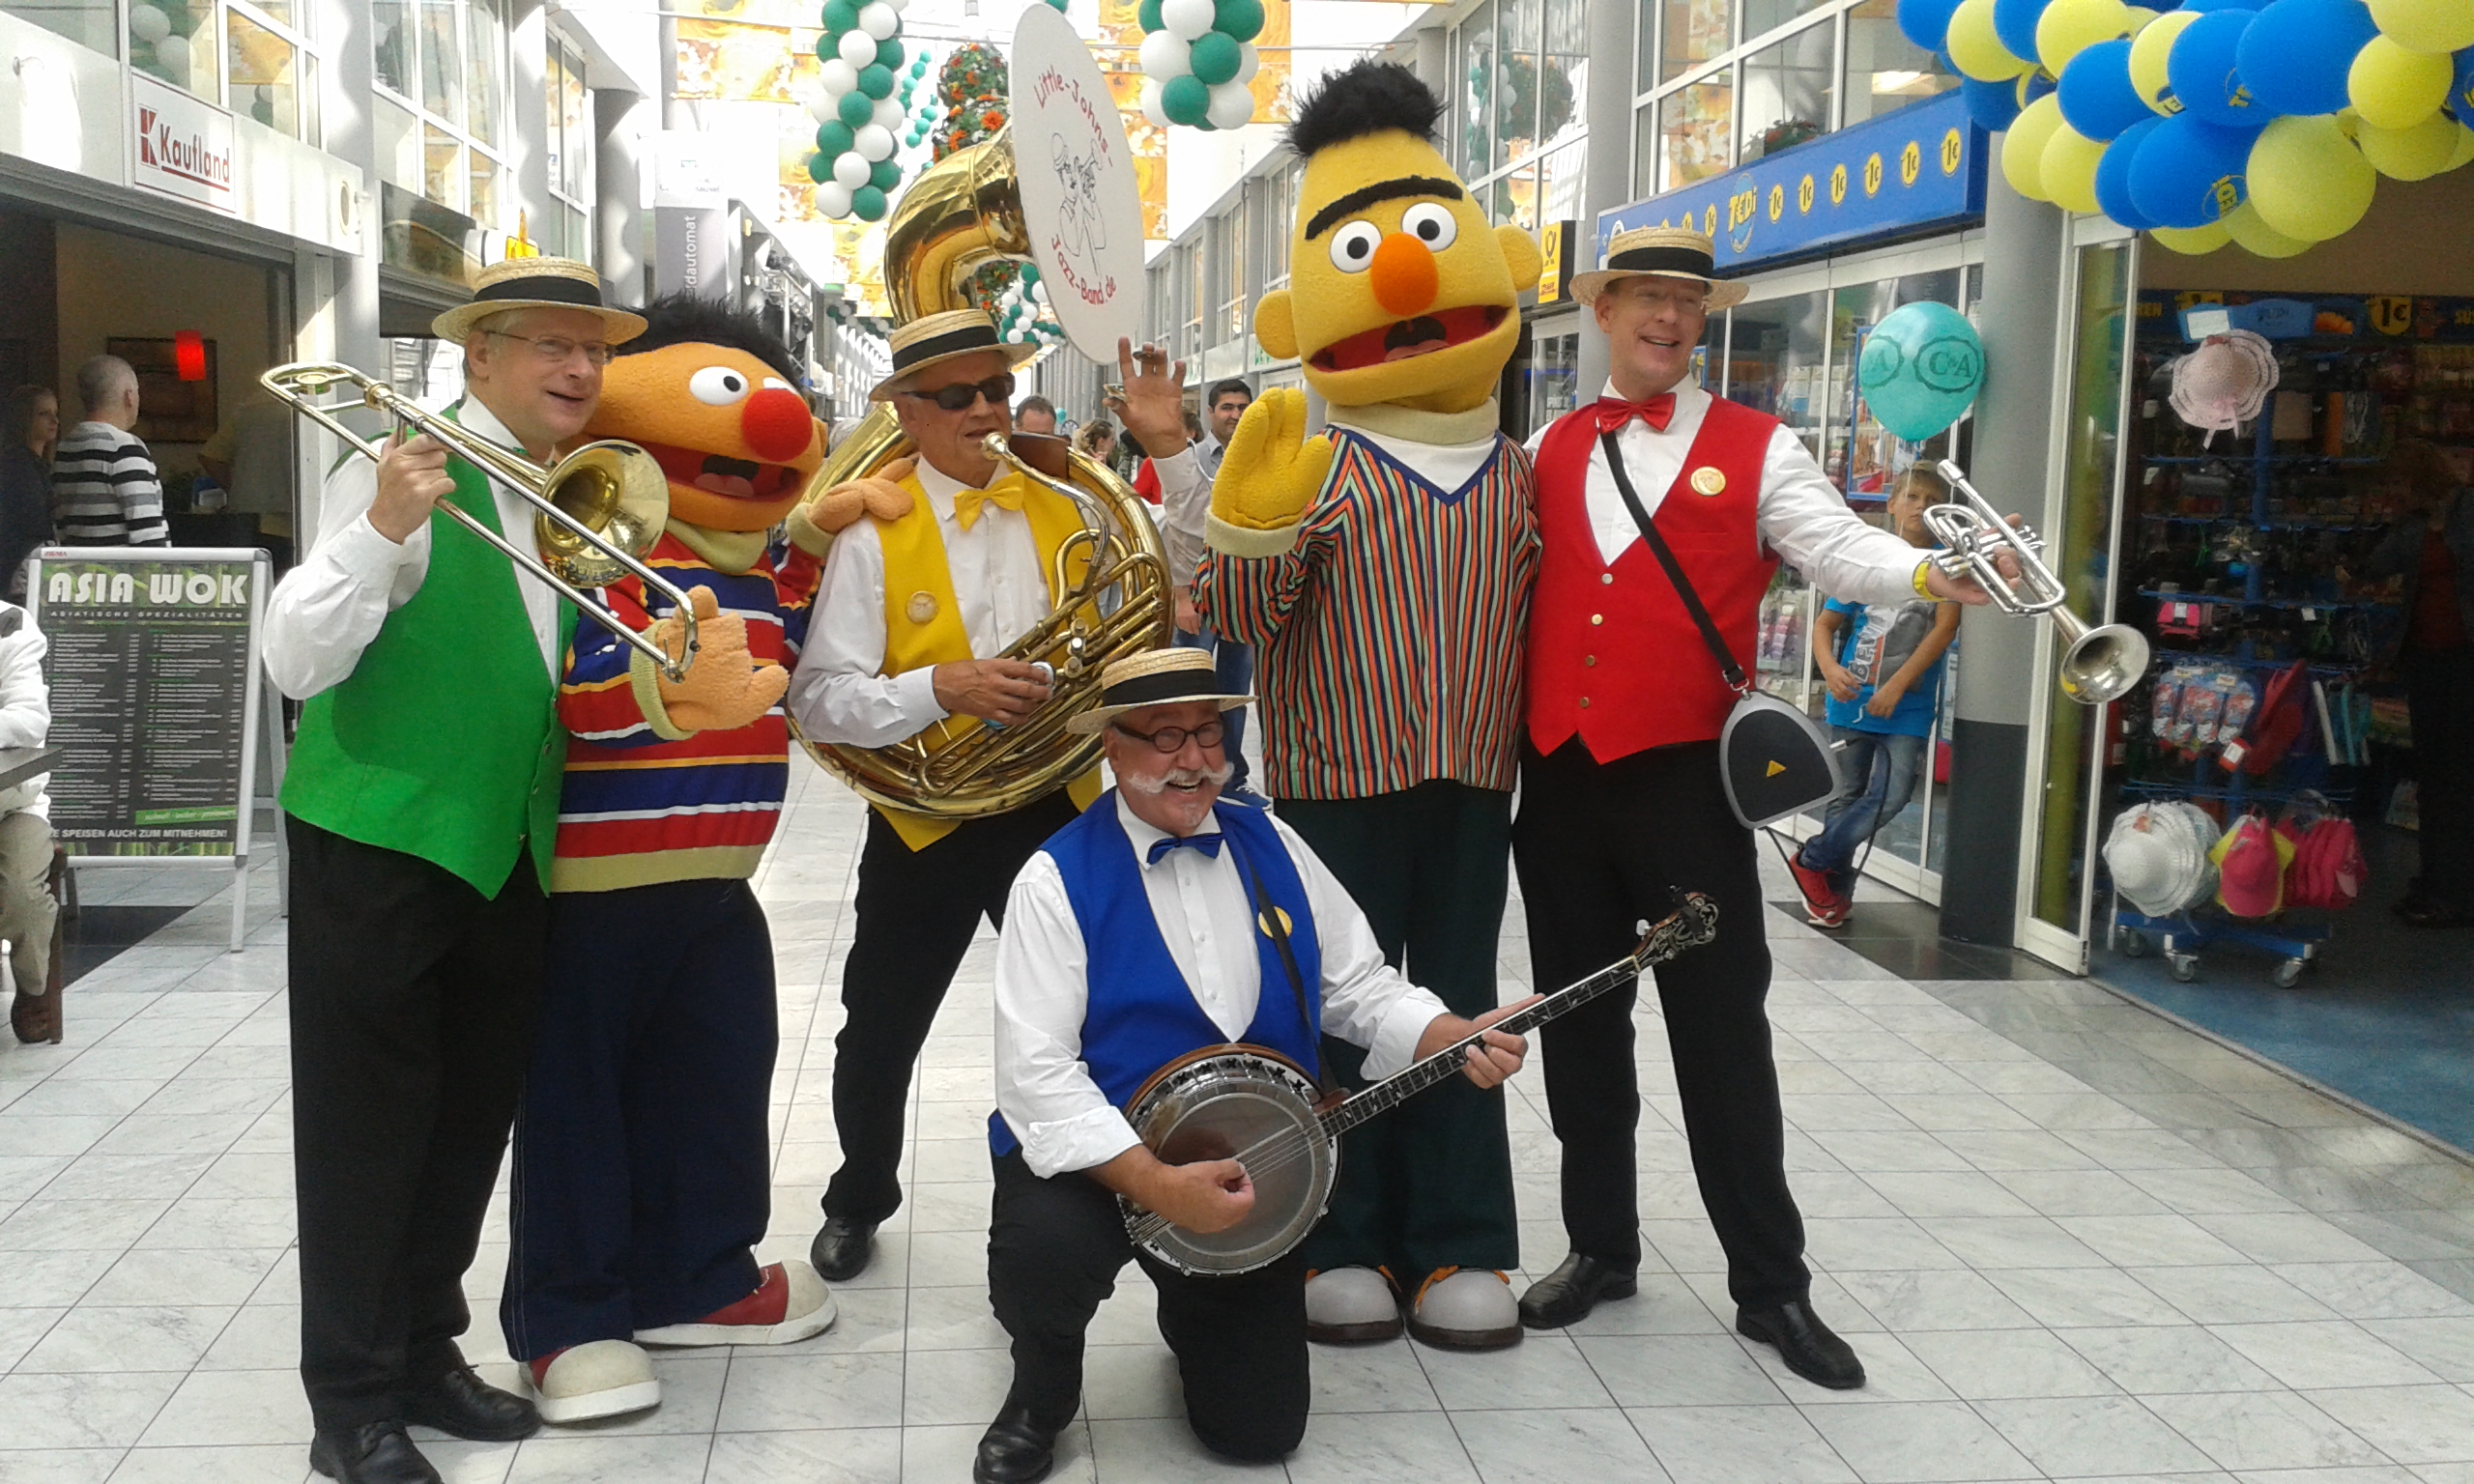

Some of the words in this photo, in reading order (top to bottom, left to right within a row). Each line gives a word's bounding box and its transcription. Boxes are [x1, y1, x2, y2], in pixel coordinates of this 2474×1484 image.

[159, 123, 230, 184] Kaufland
[1769, 191, 1781, 214] 1€
[1798, 183, 1812, 207] 1€
[1830, 172, 1845, 197] 1€
[1864, 161, 1880, 188] 1€
[1901, 151, 1917, 178] 1€
[1941, 138, 1958, 166] 1€
[684, 215, 697, 298] ldautomat
[2378, 298, 2408, 328] 1€
[1929, 351, 1971, 378] C&A
[48, 572, 134, 604] ASIA
[149, 573, 248, 605] WOK
[138, 610, 242, 618] SPEZIALITÄTEN
[61, 829, 105, 838] SPEISEN
[107, 829, 136, 838] AUCH
[138, 829, 160, 838] ZUM
[162, 829, 228, 838] MITNEHMEN!
